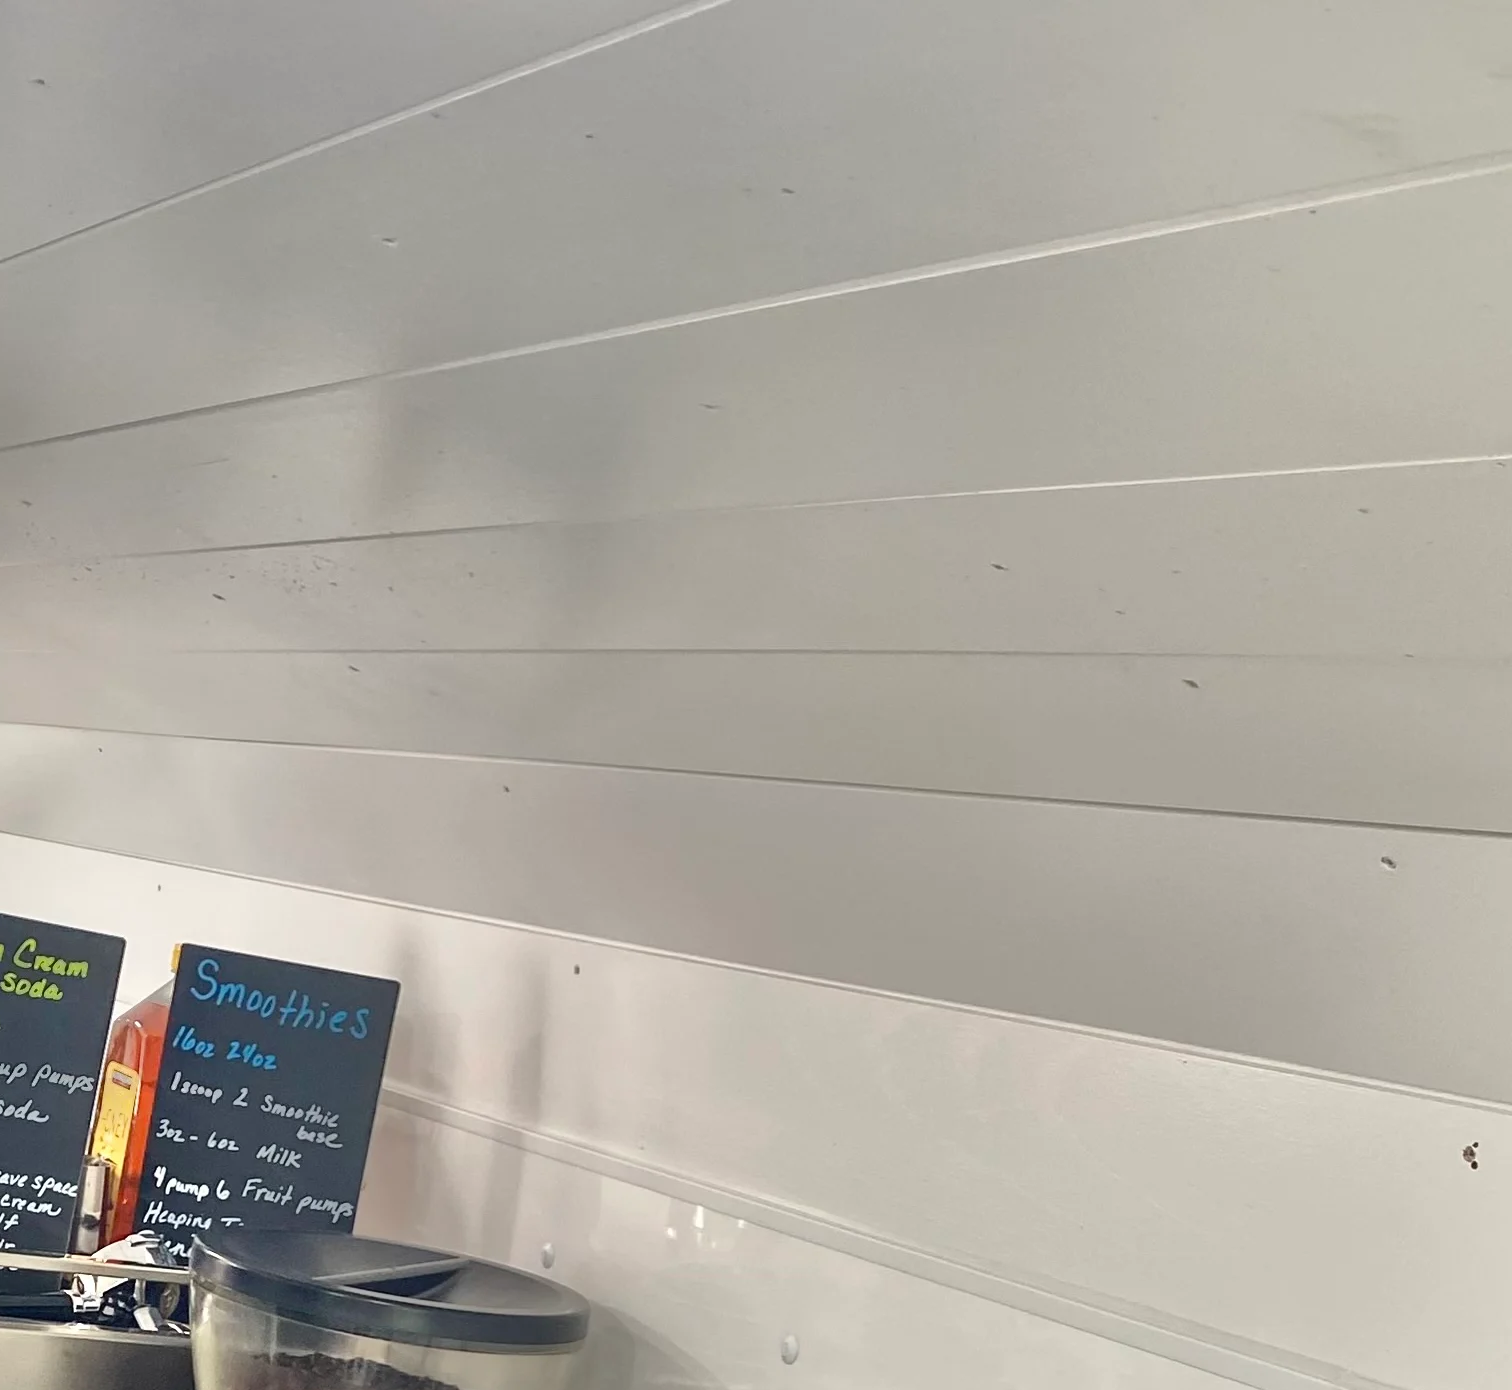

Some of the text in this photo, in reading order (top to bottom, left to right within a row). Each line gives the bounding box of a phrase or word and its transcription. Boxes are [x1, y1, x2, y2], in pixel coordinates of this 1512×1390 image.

[13, 938, 88, 978] Cream
[190, 958, 369, 1040] Smoothies
[173, 1025, 276, 1070] 16oz 24oz
[233, 1087, 248, 1107] 2
[156, 1119, 185, 1142] 3oz
[207, 1131, 239, 1151] 6oz
[256, 1145, 302, 1168] Milk
[297, 1127, 342, 1148] base
[31, 1174, 79, 1198] space
[216, 1179, 230, 1200] 6
[242, 1179, 292, 1205] Fruit
[296, 1197, 354, 1223] pumps
[0, 1194, 62, 1217] cream
[143, 1201, 212, 1230] Heaping
